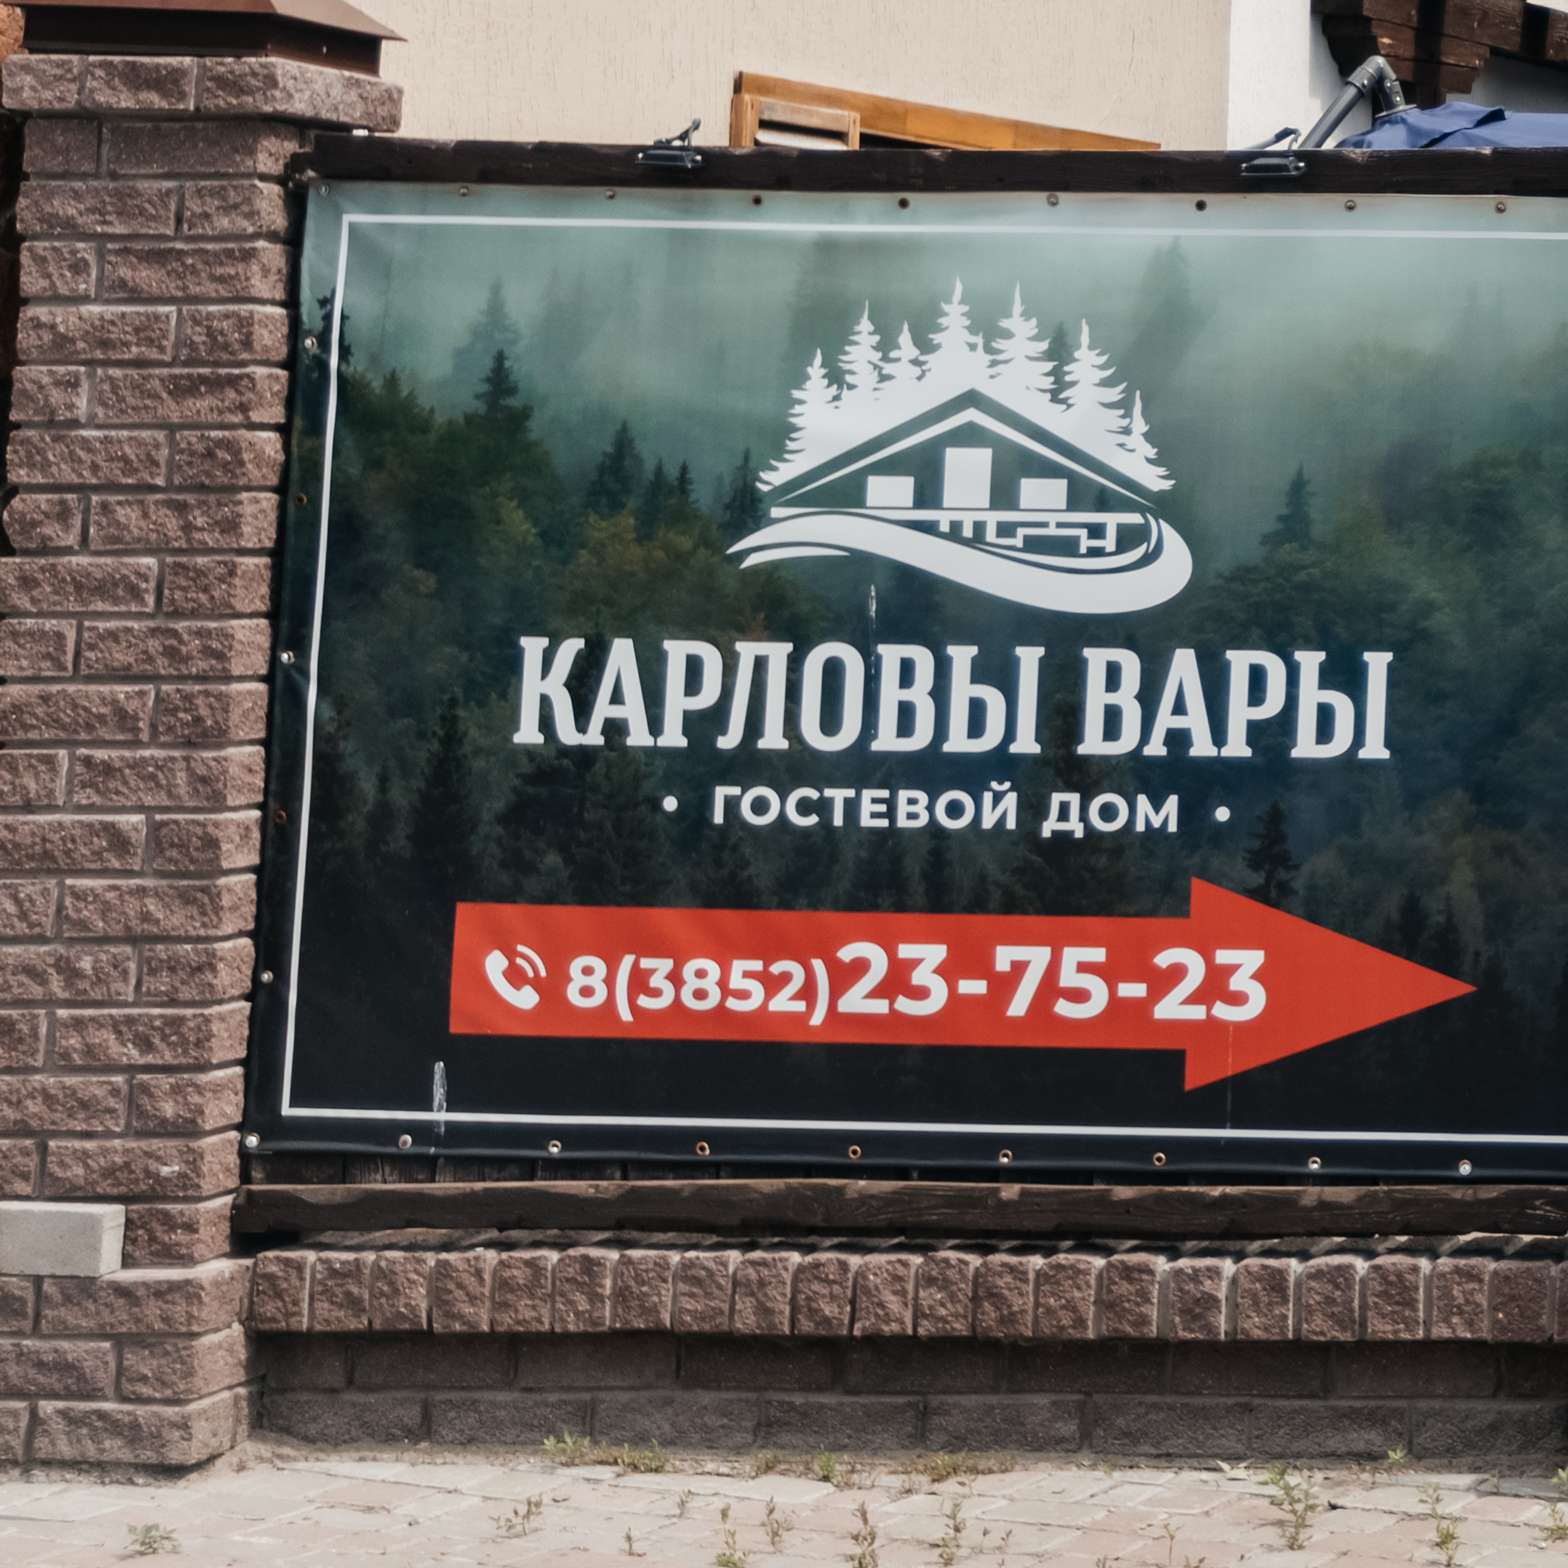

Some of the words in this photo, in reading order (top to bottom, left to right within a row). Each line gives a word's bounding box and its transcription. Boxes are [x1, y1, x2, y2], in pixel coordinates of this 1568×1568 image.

[513, 635, 1045, 756] КАРЛОВЫ
[1077, 646, 1393, 760] ВАРЫ
[713, 781, 1019, 831] ГОСТЕВОЙ
[1043, 793, 1179, 838] ДОМ
[566, 940, 1267, 1026] 8(3852)23-75-23
